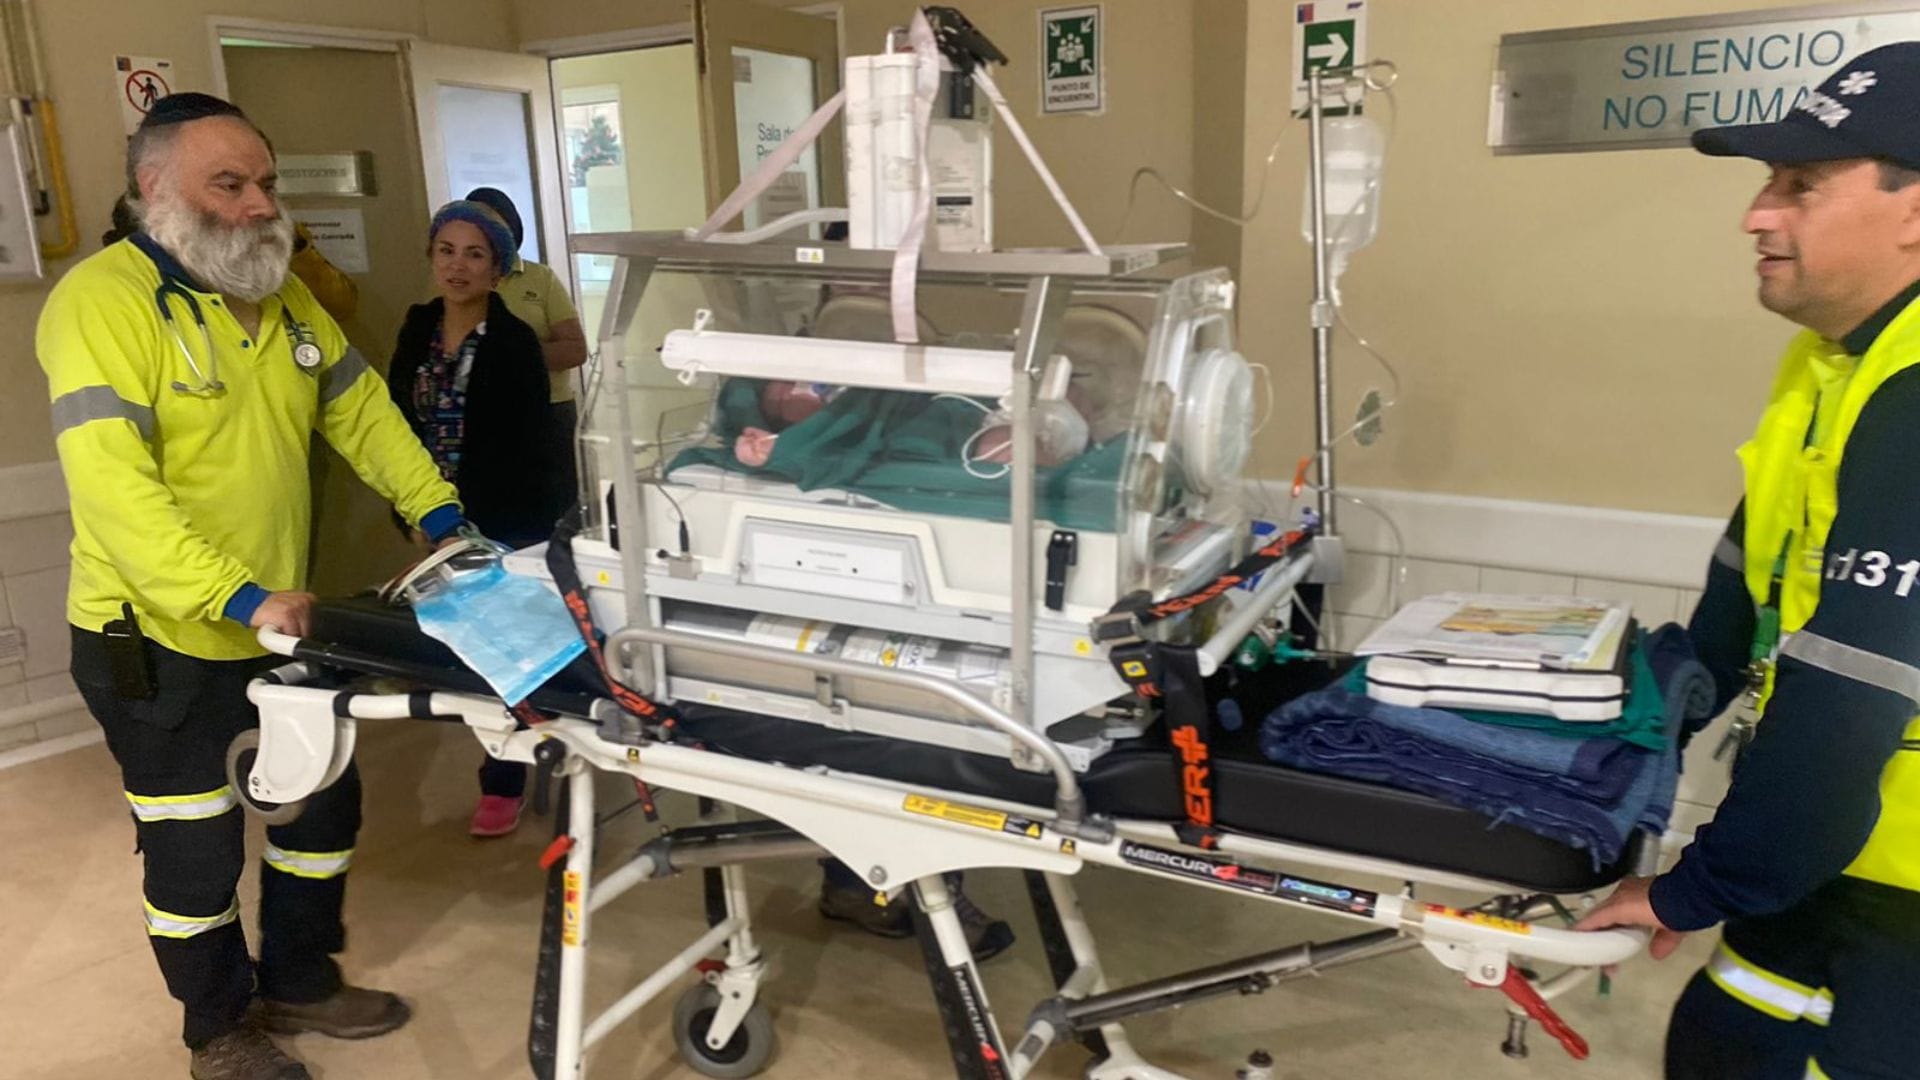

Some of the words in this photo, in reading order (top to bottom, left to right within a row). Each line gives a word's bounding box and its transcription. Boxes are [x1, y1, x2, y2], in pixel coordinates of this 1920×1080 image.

[1622, 30, 1844, 79] SILENCIO
[1603, 94, 1667, 130] NO
[1683, 85, 1809, 127] FUMA
[758, 122, 781, 141] Sala
